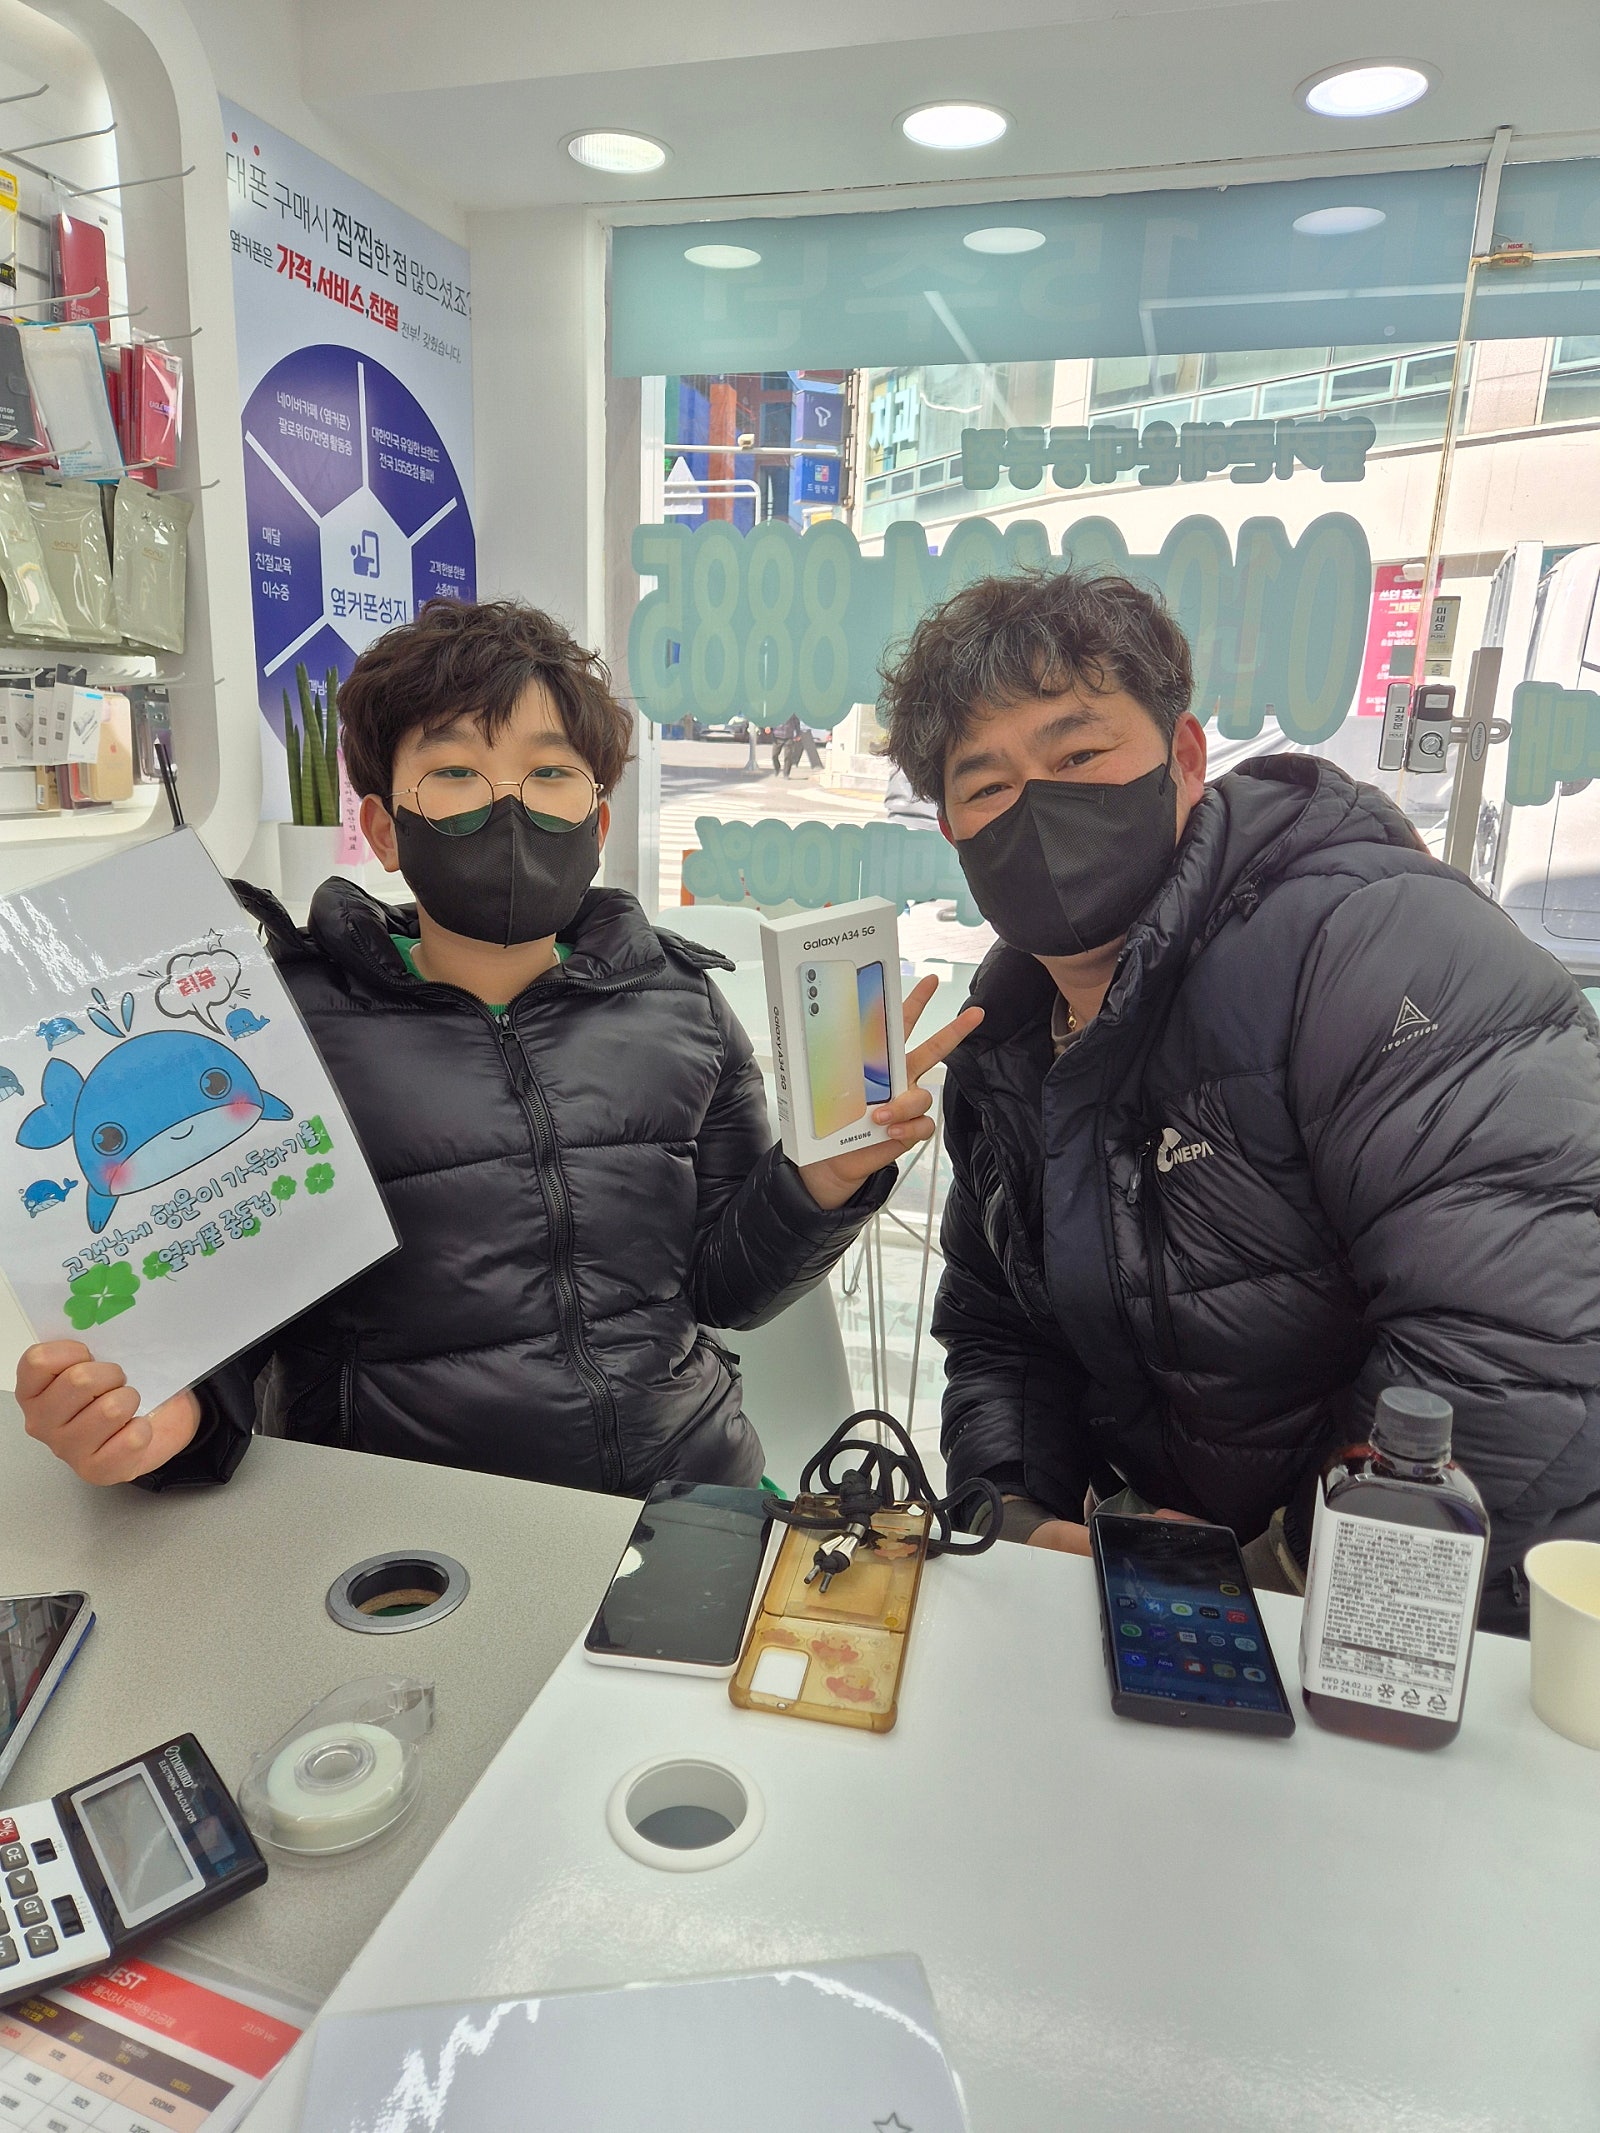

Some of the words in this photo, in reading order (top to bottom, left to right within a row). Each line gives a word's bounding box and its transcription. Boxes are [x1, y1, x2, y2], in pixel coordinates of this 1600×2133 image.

[273, 181, 327, 243] 구매시
[332, 208, 390, 276] 찝찝한
[230, 229, 273, 268] 옆커폰은
[277, 391, 318, 420] 네이버카페
[371, 427, 400, 450] 대한민국
[379, 453, 393, 471] 전국
[262, 527, 280, 546] 매달
[255, 552, 292, 575] 친절교육
[262, 581, 289, 601] 이수중
[330, 587, 407, 624] 옆커폰성지
[1434, 607, 1446, 632] 미세요
[803, 934, 841, 951] Galaxy
[841, 929, 859, 942] A34
[861, 925, 876, 937] 5G
[773, 1006, 783, 1051] Galaxy
[839, 1130, 872, 1146] SAMSUNG
[62, 1221, 153, 1283] 고객님께
[150, 1178, 224, 1229] 행운이
[220, 1120, 321, 1188] 가득하기를
[158, 1221, 225, 1272] 옆커폰
[218, 1191, 276, 1239] 중동점
[1321, 1682, 1338, 1690] EXP
[158, 1760, 176, 1791] ELECTRONIC
[174, 1789, 197, 1824] CALCULATOR
[6, 1847, 22, 1863] CE
[23, 1900, 40, 1915] GT
